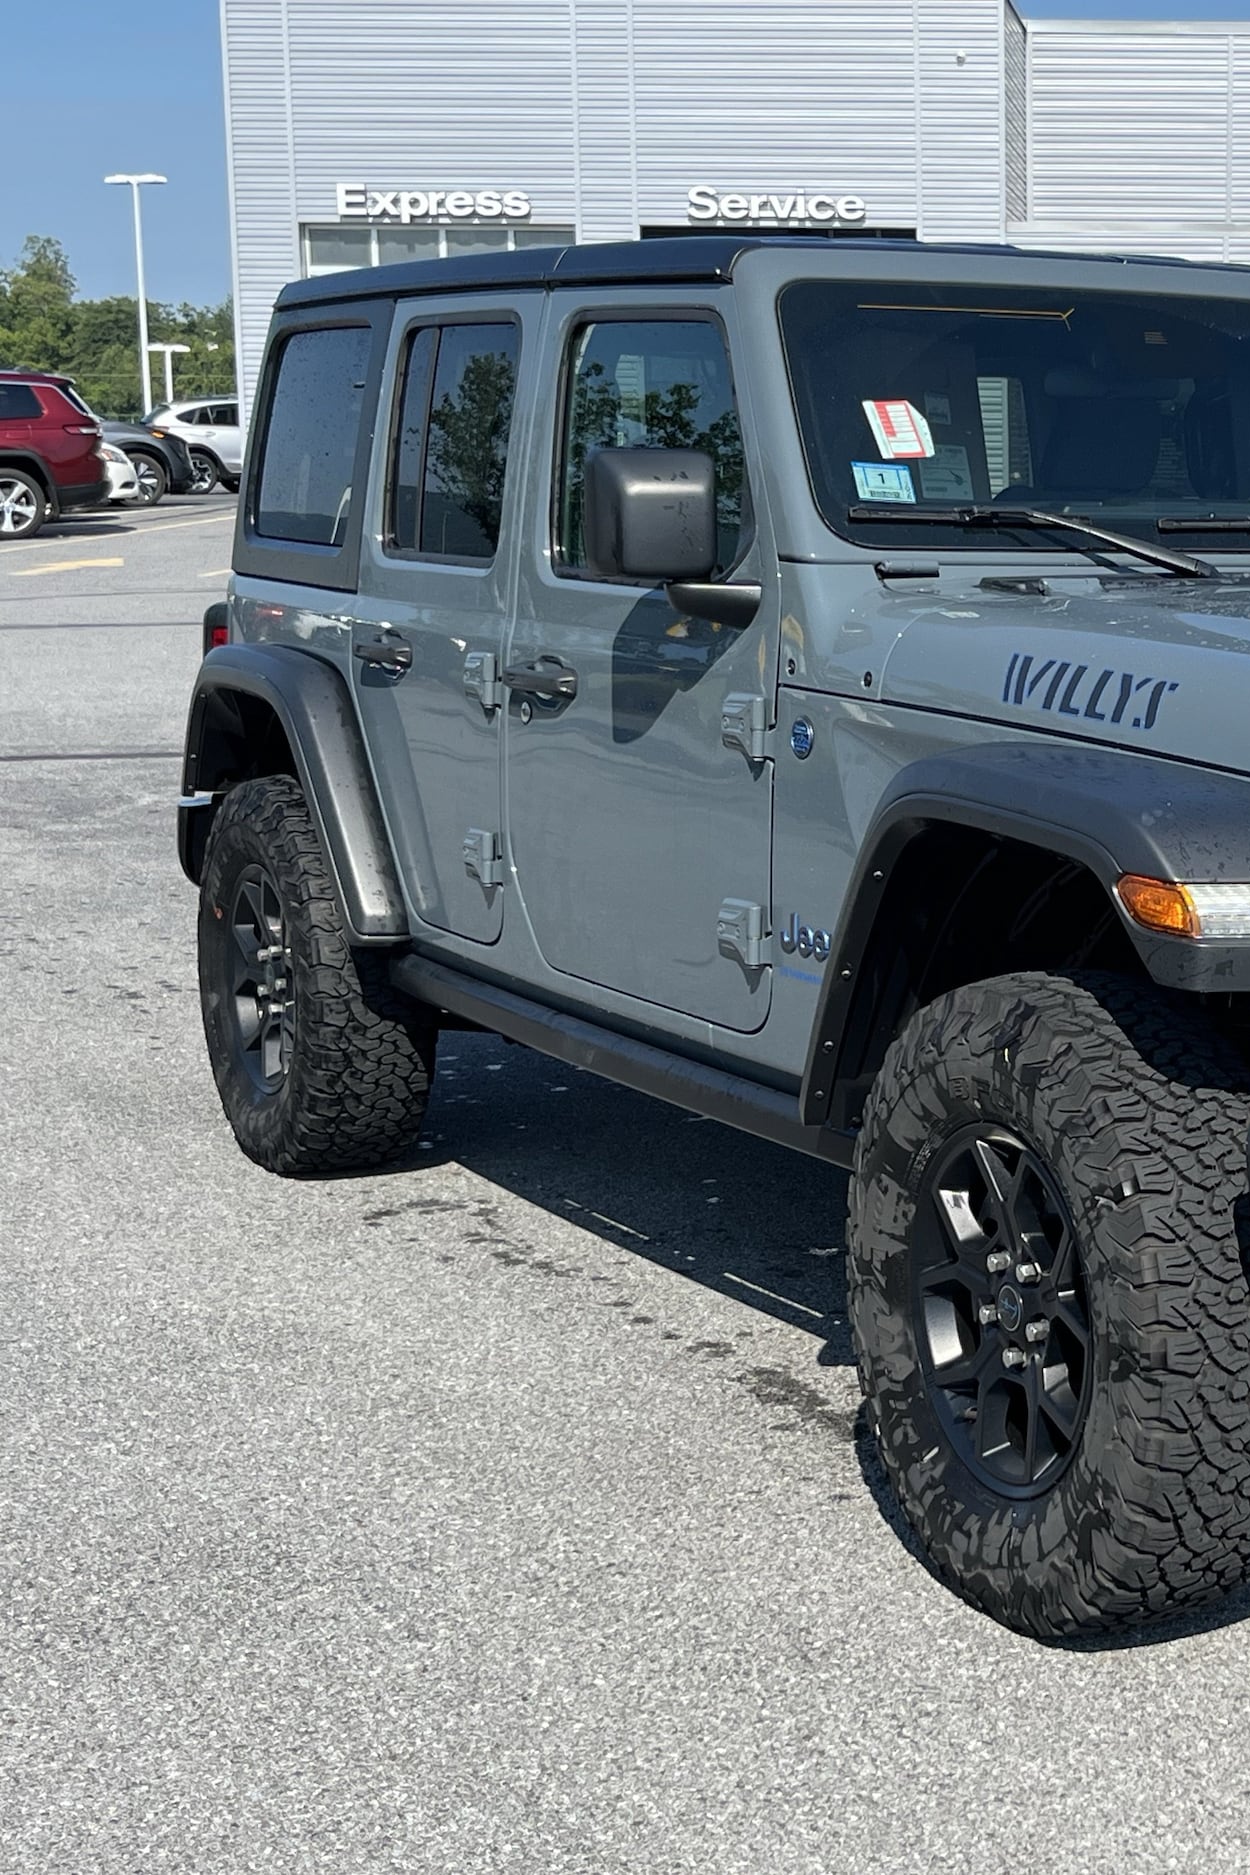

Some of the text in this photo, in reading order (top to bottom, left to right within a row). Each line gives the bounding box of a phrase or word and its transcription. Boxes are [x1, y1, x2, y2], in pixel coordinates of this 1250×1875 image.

[336, 183, 531, 224] Express
[687, 185, 867, 220] Service
[877, 472, 886, 485] 1
[1002, 653, 1180, 730] WILLYS
[780, 911, 832, 963] Jee
